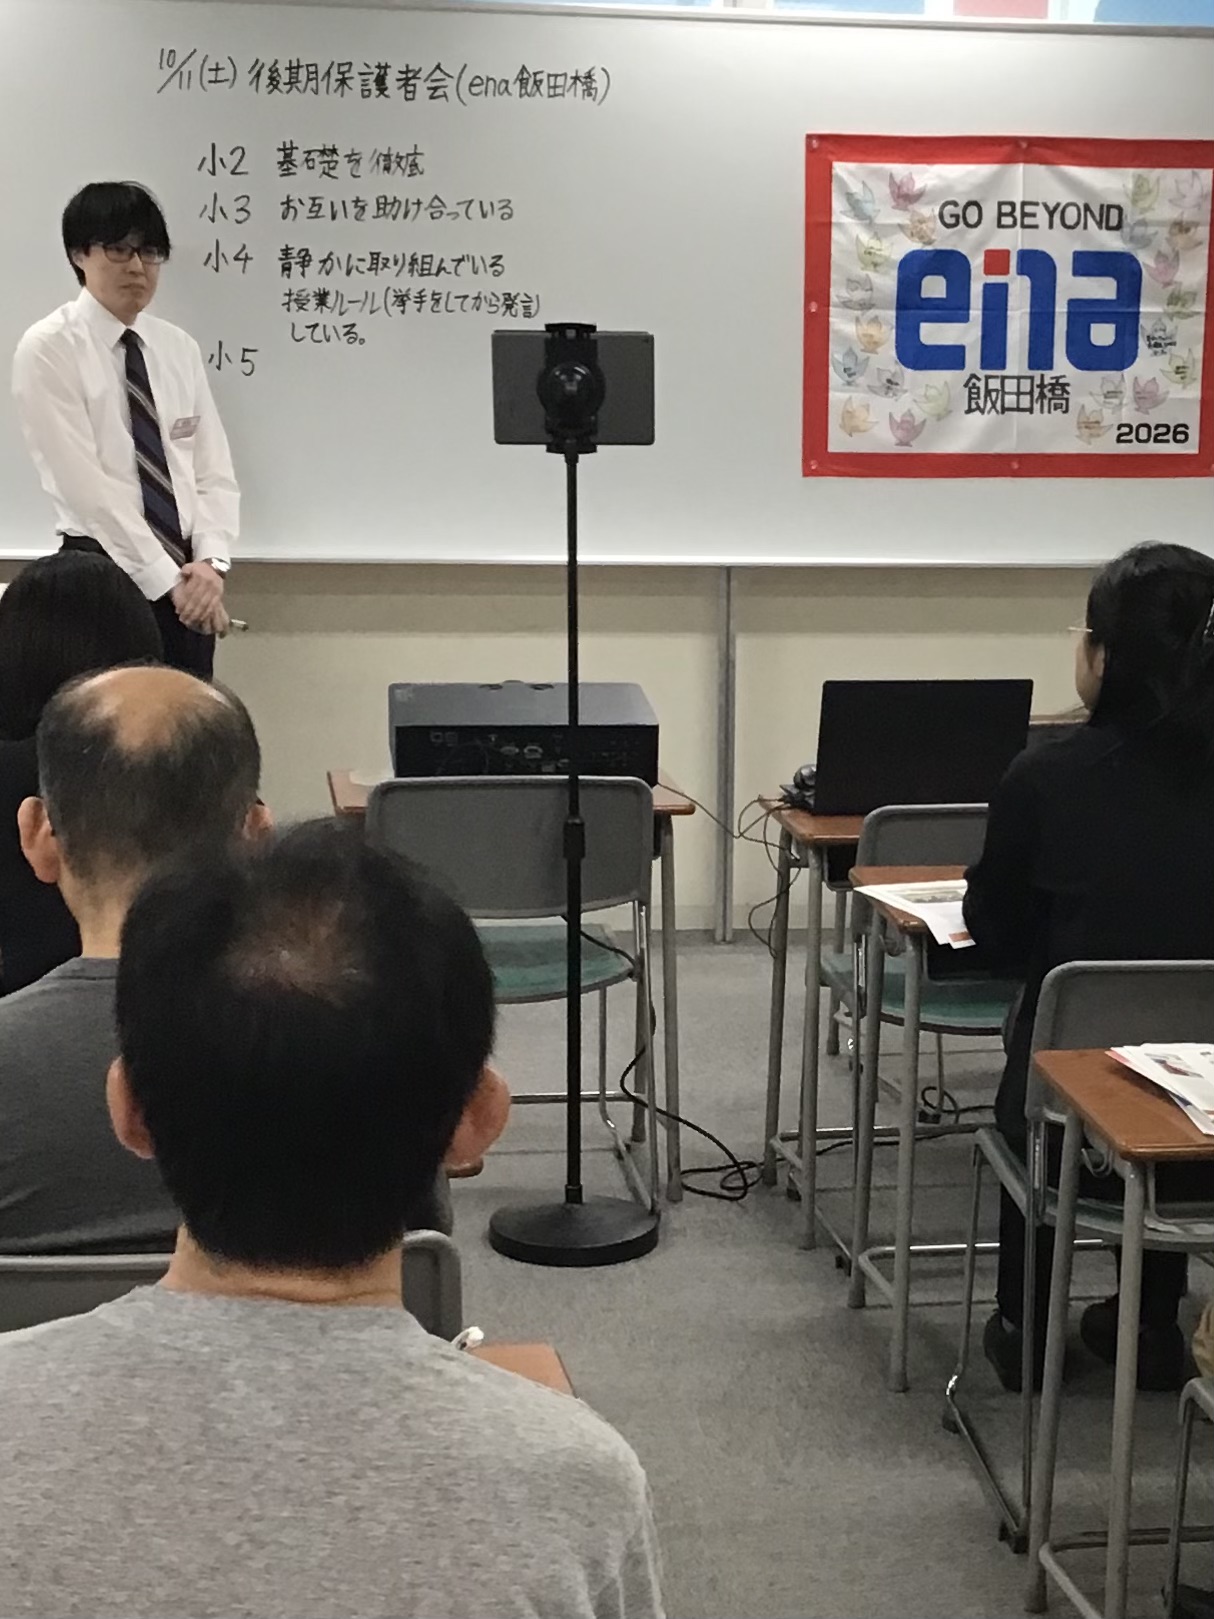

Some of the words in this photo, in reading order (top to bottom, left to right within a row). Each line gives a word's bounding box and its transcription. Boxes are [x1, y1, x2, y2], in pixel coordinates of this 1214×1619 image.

[197, 143, 249, 177] 小2
[199, 192, 252, 224] 小3
[279, 194, 514, 222] お互いを助け合っている
[938, 200, 983, 229] GO
[996, 201, 1124, 231] BEYOND
[203, 239, 254, 274] 小4
[278, 244, 505, 280] 静かに取り組んでいる
[895, 248, 1142, 371] ena
[208, 340, 259, 377] 小5
[963, 373, 1071, 415] 飯田橋
[1115, 422, 1190, 444] 2026
